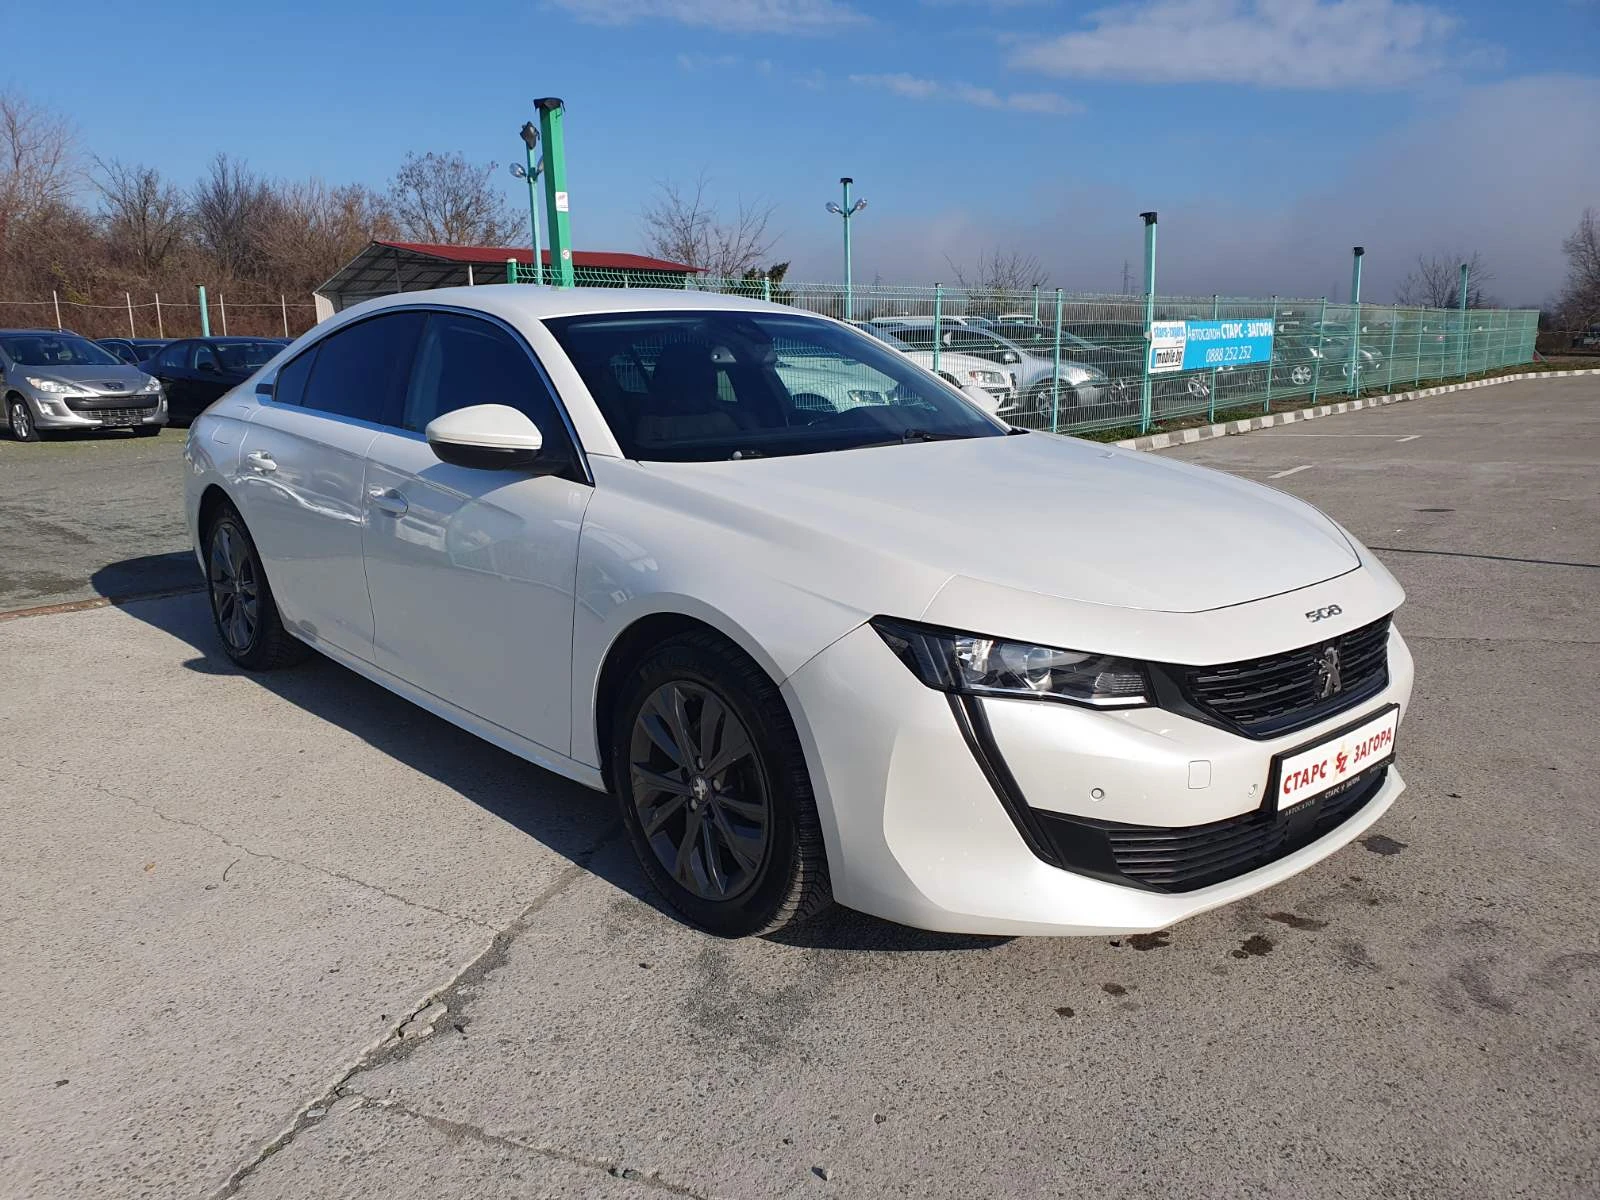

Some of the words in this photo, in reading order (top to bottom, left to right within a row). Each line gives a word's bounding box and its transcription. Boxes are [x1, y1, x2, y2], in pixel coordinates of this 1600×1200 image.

[1187, 325, 1220, 341] Автосалон
[1221, 323, 1243, 339] СТАРС
[1247, 322, 1273, 337] ЗАГОРА
[1206, 348, 1224, 363] 0888
[1225, 346, 1238, 361] 252
[1239, 345, 1252, 360] 252
[1305, 604, 1342, 623] 508
[1283, 759, 1328, 794] СТАРС
[1354, 727, 1392, 764] ЗАГОРА
